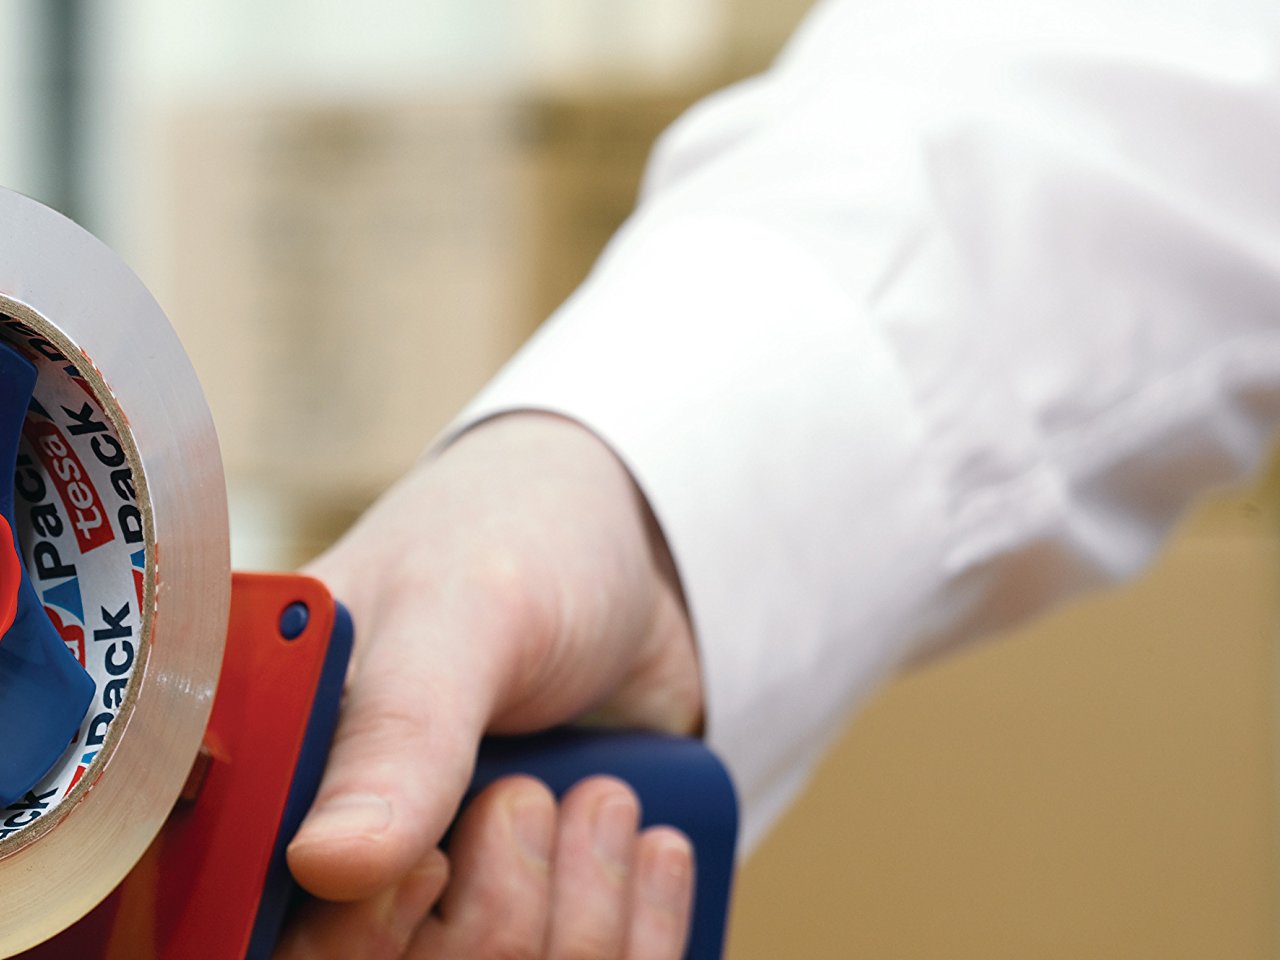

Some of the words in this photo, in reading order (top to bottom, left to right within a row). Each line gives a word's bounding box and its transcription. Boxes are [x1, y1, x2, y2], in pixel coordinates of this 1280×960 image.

[39, 434, 103, 540] tesa
[61, 402, 144, 544] Pack
[86, 602, 135, 746] Pack
